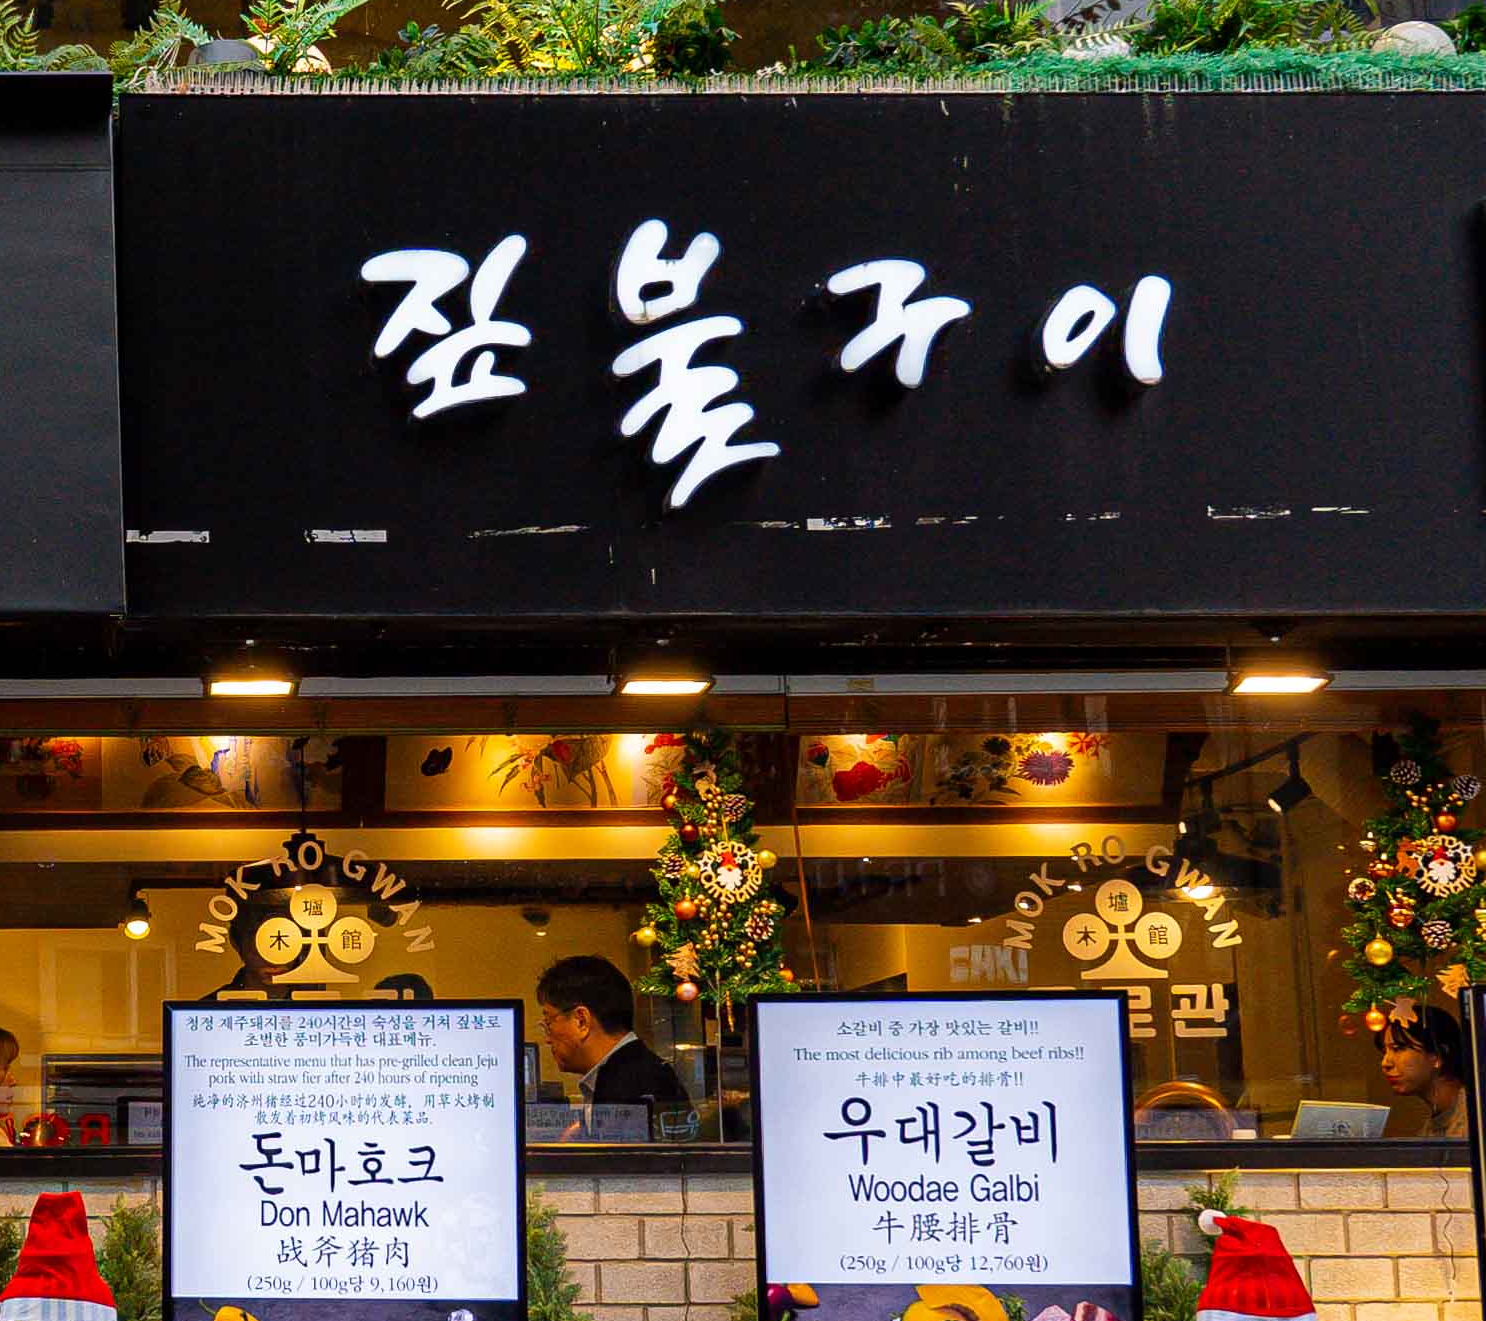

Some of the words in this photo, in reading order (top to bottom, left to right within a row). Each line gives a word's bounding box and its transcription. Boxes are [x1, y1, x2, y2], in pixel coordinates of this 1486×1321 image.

[359, 218, 1172, 512] 짚불구이
[195, 864, 261, 954] MOK
[342, 849, 435, 954] GWAN
[836, 1021, 883, 1038] 소갈비
[887, 1021, 905, 1038] 중
[908, 1021, 941, 1037] 가장
[945, 1020, 992, 1037] 맛있는
[997, 1020, 1040, 1036] 갈비!!
[793, 1047, 823, 1061] The
[825, 1048, 860, 1061] most
[864, 1047, 930, 1061] delicious
[933, 1046, 953, 1060] rib
[957, 1049, 1008, 1064] among
[1011, 1046, 1044, 1060] beef
[1048, 1046, 1086, 1060] ribs!!
[823, 1096, 1059, 1167] 우대갈비
[239, 1131, 445, 1196] 돈마호크
[847, 1173, 960, 1202] Woodae
[968, 1172, 1040, 1202] Galbi
[260, 1200, 311, 1228] Don
[322, 1200, 430, 1229] Mahawk
[871, 1209, 1019, 1246] 牛腰排骨
